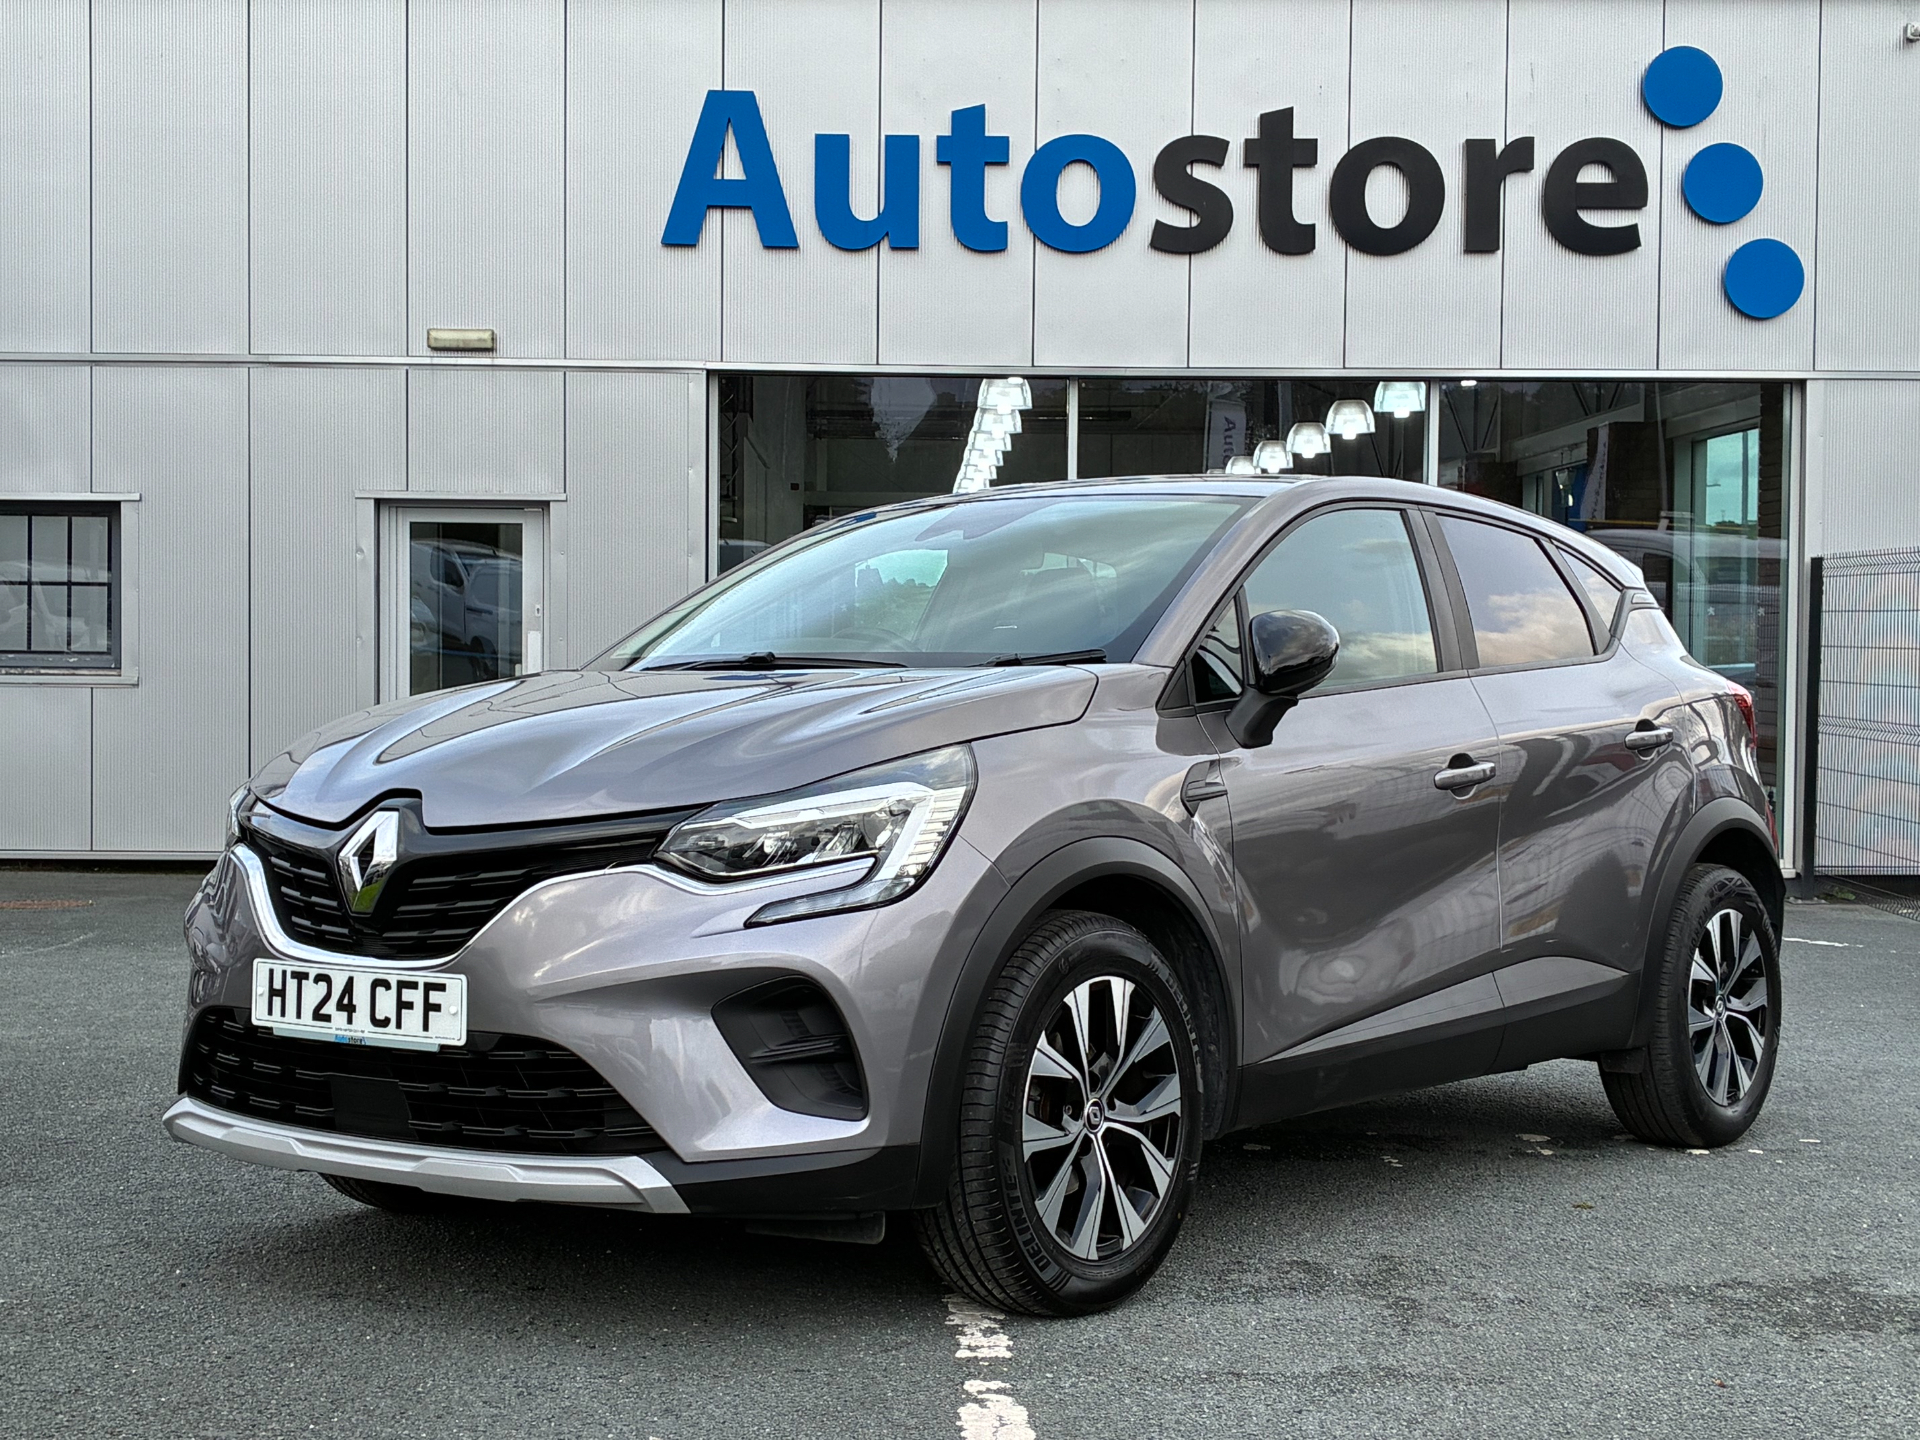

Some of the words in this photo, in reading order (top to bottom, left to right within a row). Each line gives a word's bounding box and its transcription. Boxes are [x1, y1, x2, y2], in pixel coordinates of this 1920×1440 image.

[661, 89, 1649, 257] Autostore
[267, 968, 357, 1026] HT24
[369, 977, 447, 1033] CFF
